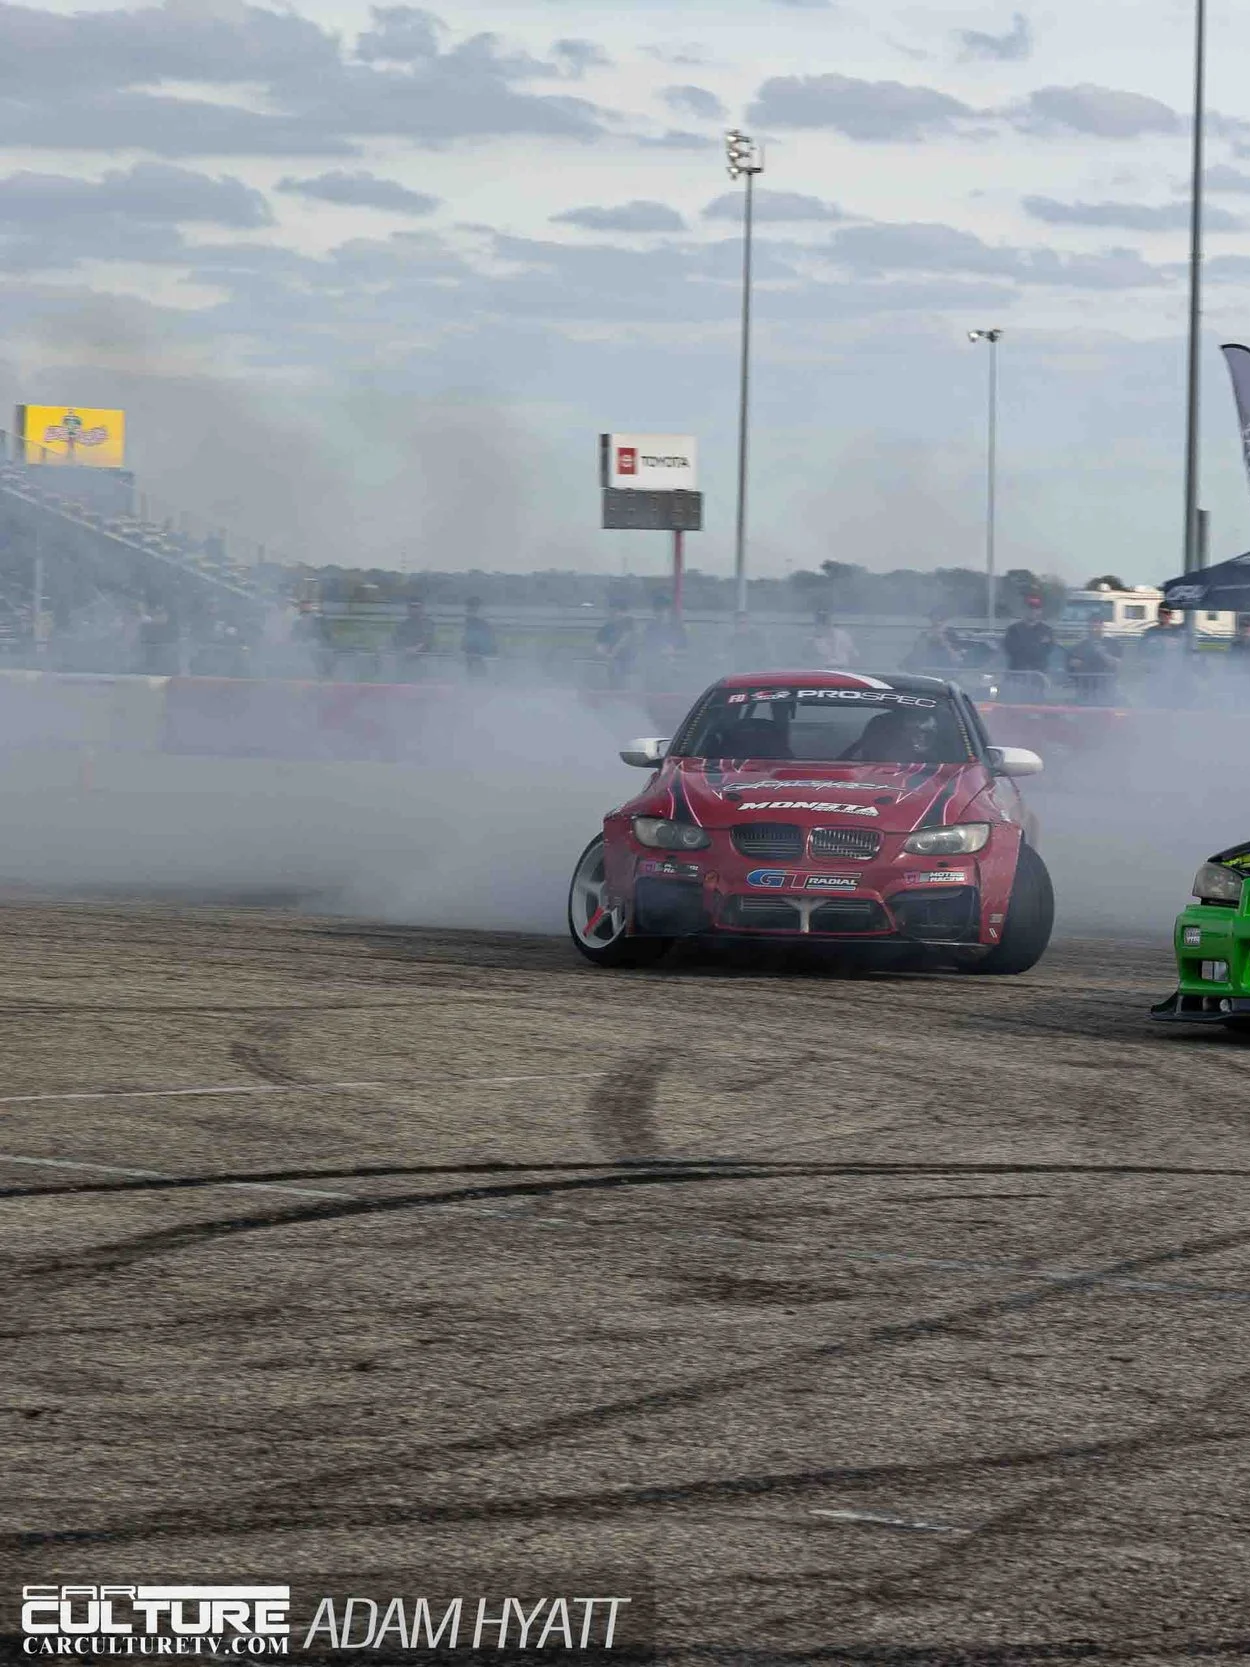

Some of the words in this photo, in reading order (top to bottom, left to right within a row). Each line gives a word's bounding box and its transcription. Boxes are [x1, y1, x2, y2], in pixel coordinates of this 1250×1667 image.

[641, 455, 690, 469] TOYOTA
[796, 689, 937, 709] PROSPEC
[737, 801, 879, 817] MONSTA
[808, 877, 858, 886] RADIAL
